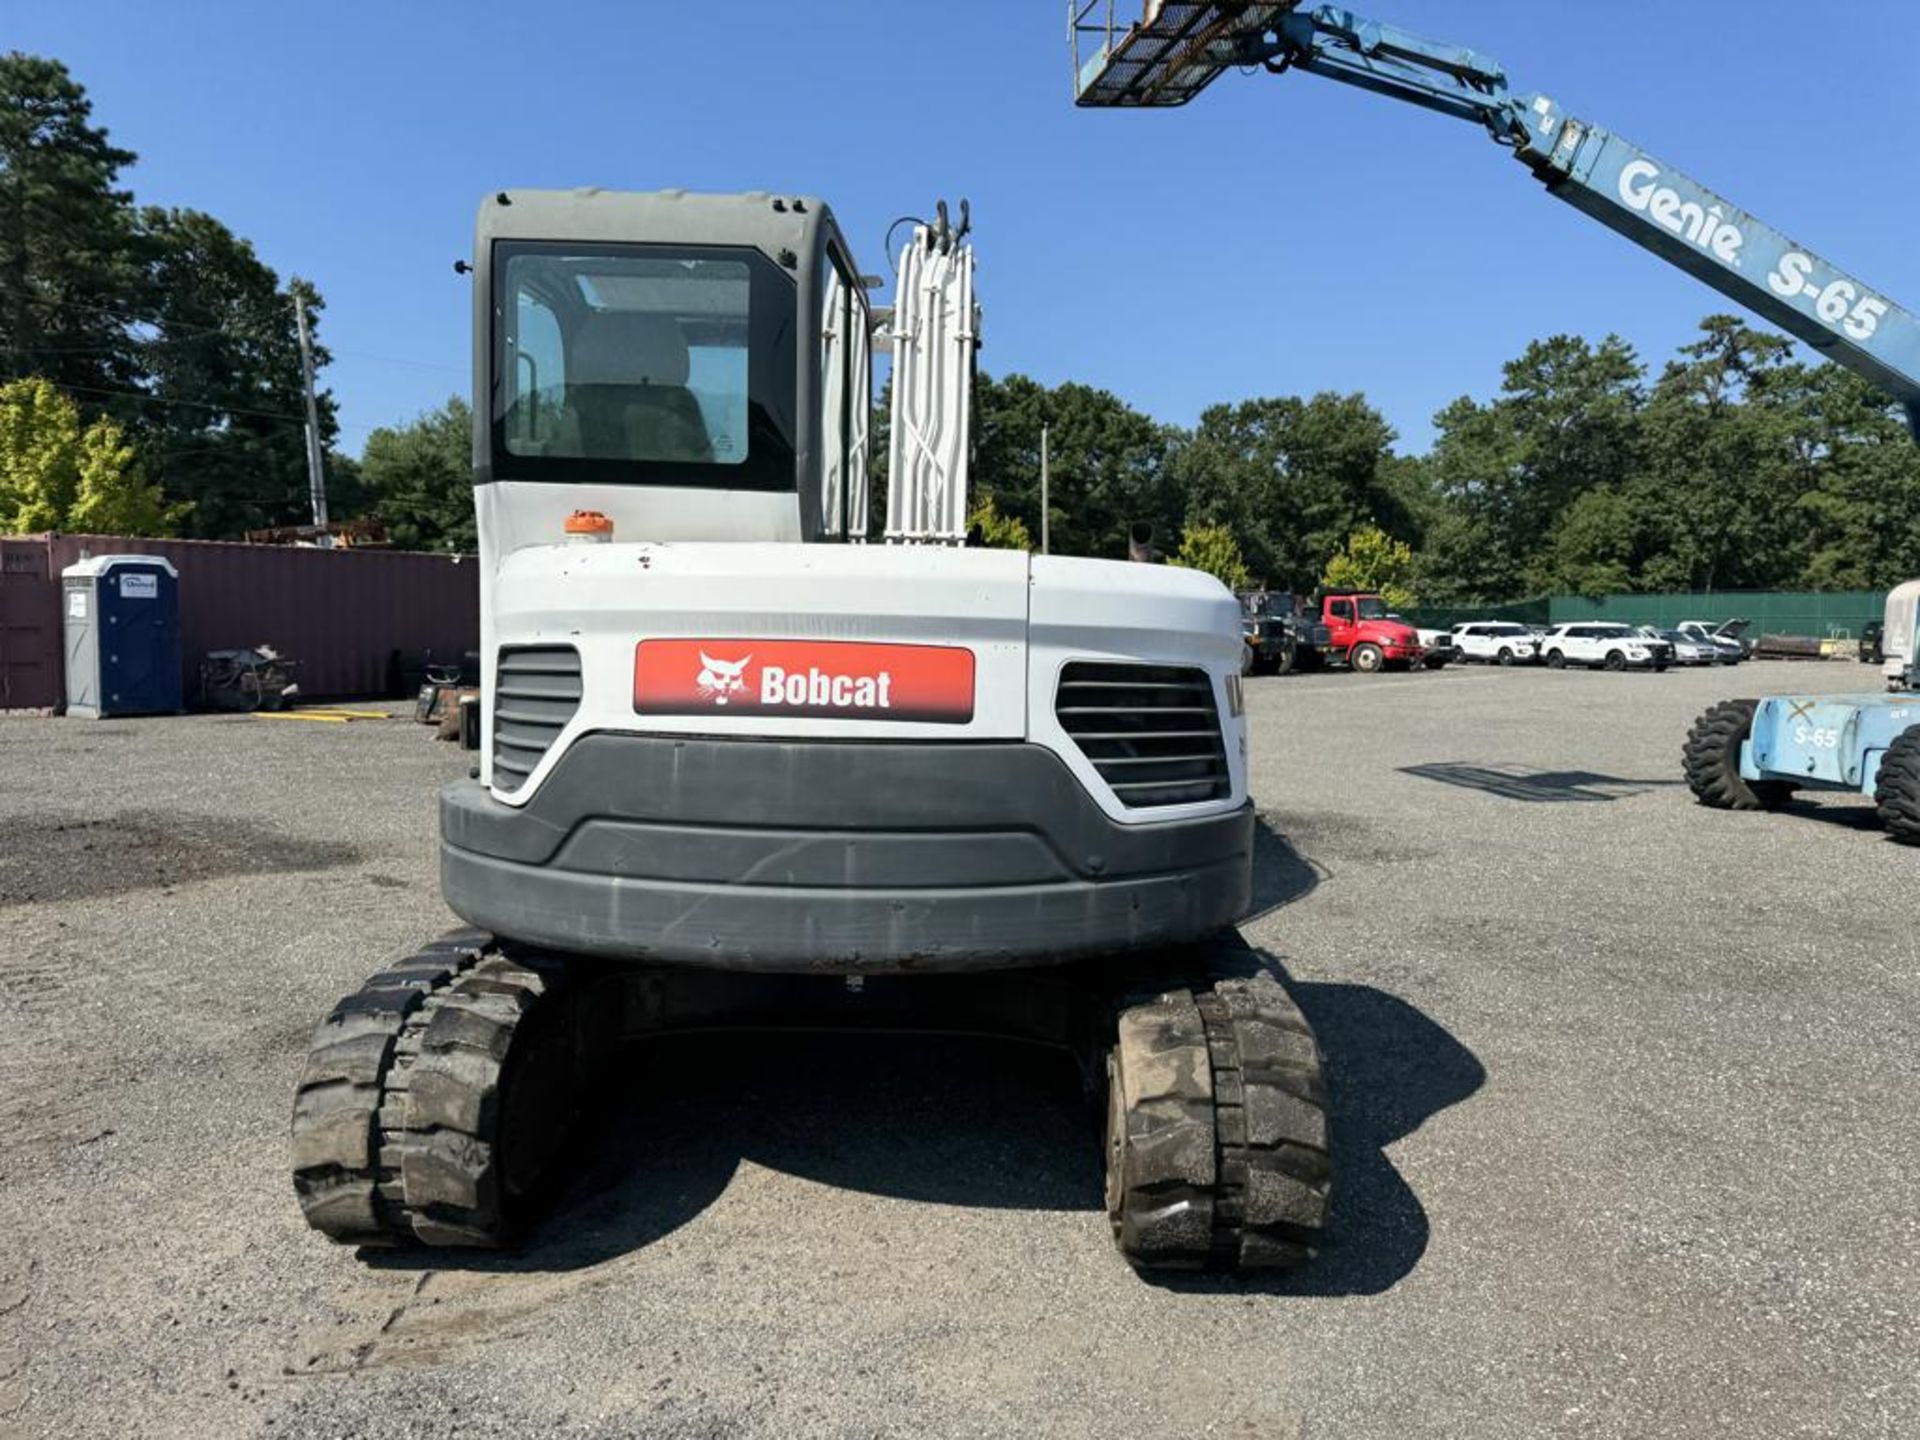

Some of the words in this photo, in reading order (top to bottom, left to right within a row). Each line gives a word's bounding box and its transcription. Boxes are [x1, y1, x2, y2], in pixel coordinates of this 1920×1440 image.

[1618, 159, 1743, 266] Genie
[1768, 252, 1888, 340] S-65
[760, 666, 891, 708] Bobcat
[1794, 726, 1838, 748] S-65
